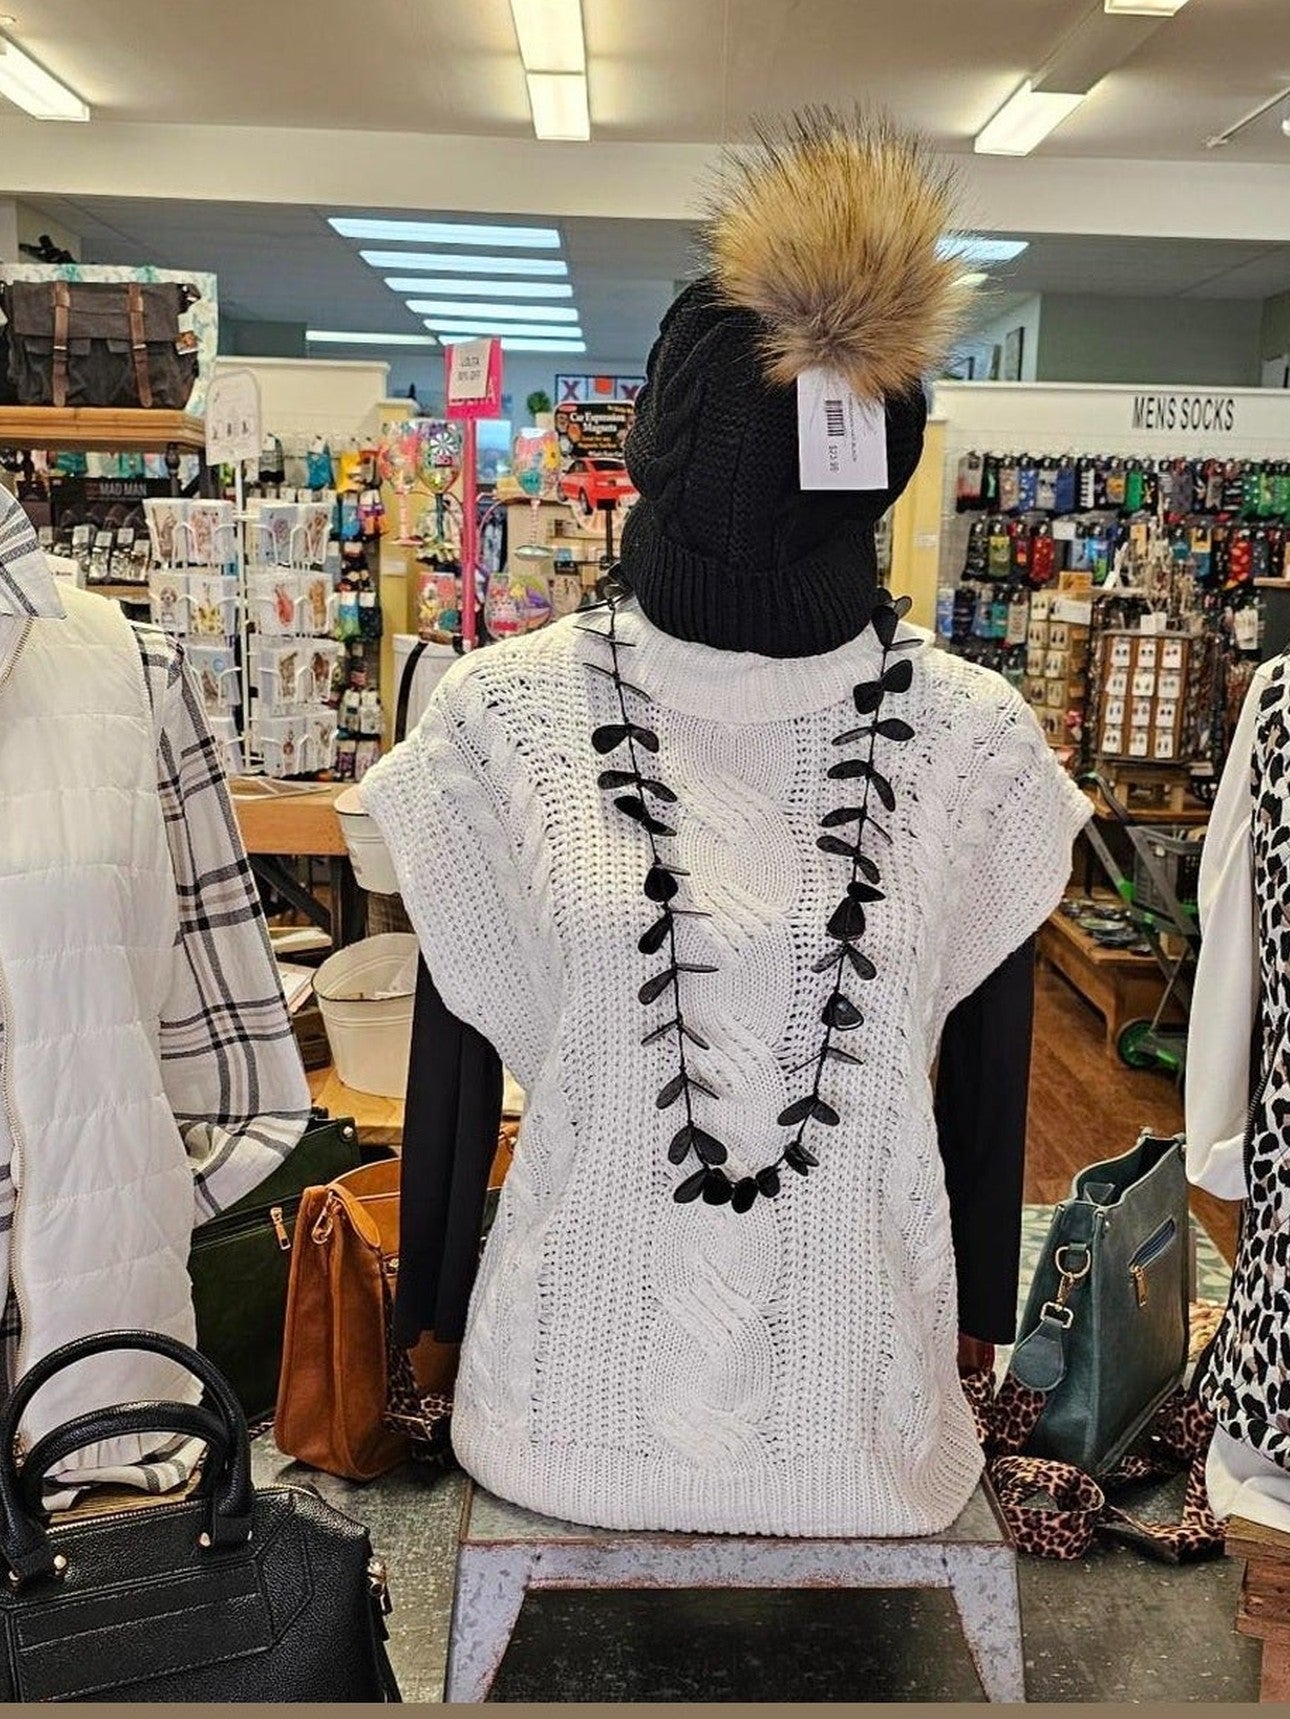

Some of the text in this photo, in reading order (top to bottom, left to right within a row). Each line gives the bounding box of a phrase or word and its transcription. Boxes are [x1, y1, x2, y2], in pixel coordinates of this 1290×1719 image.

[1132, 396, 1235, 431] MENS SOCKS
[99, 482, 148, 497] MAD MAN
